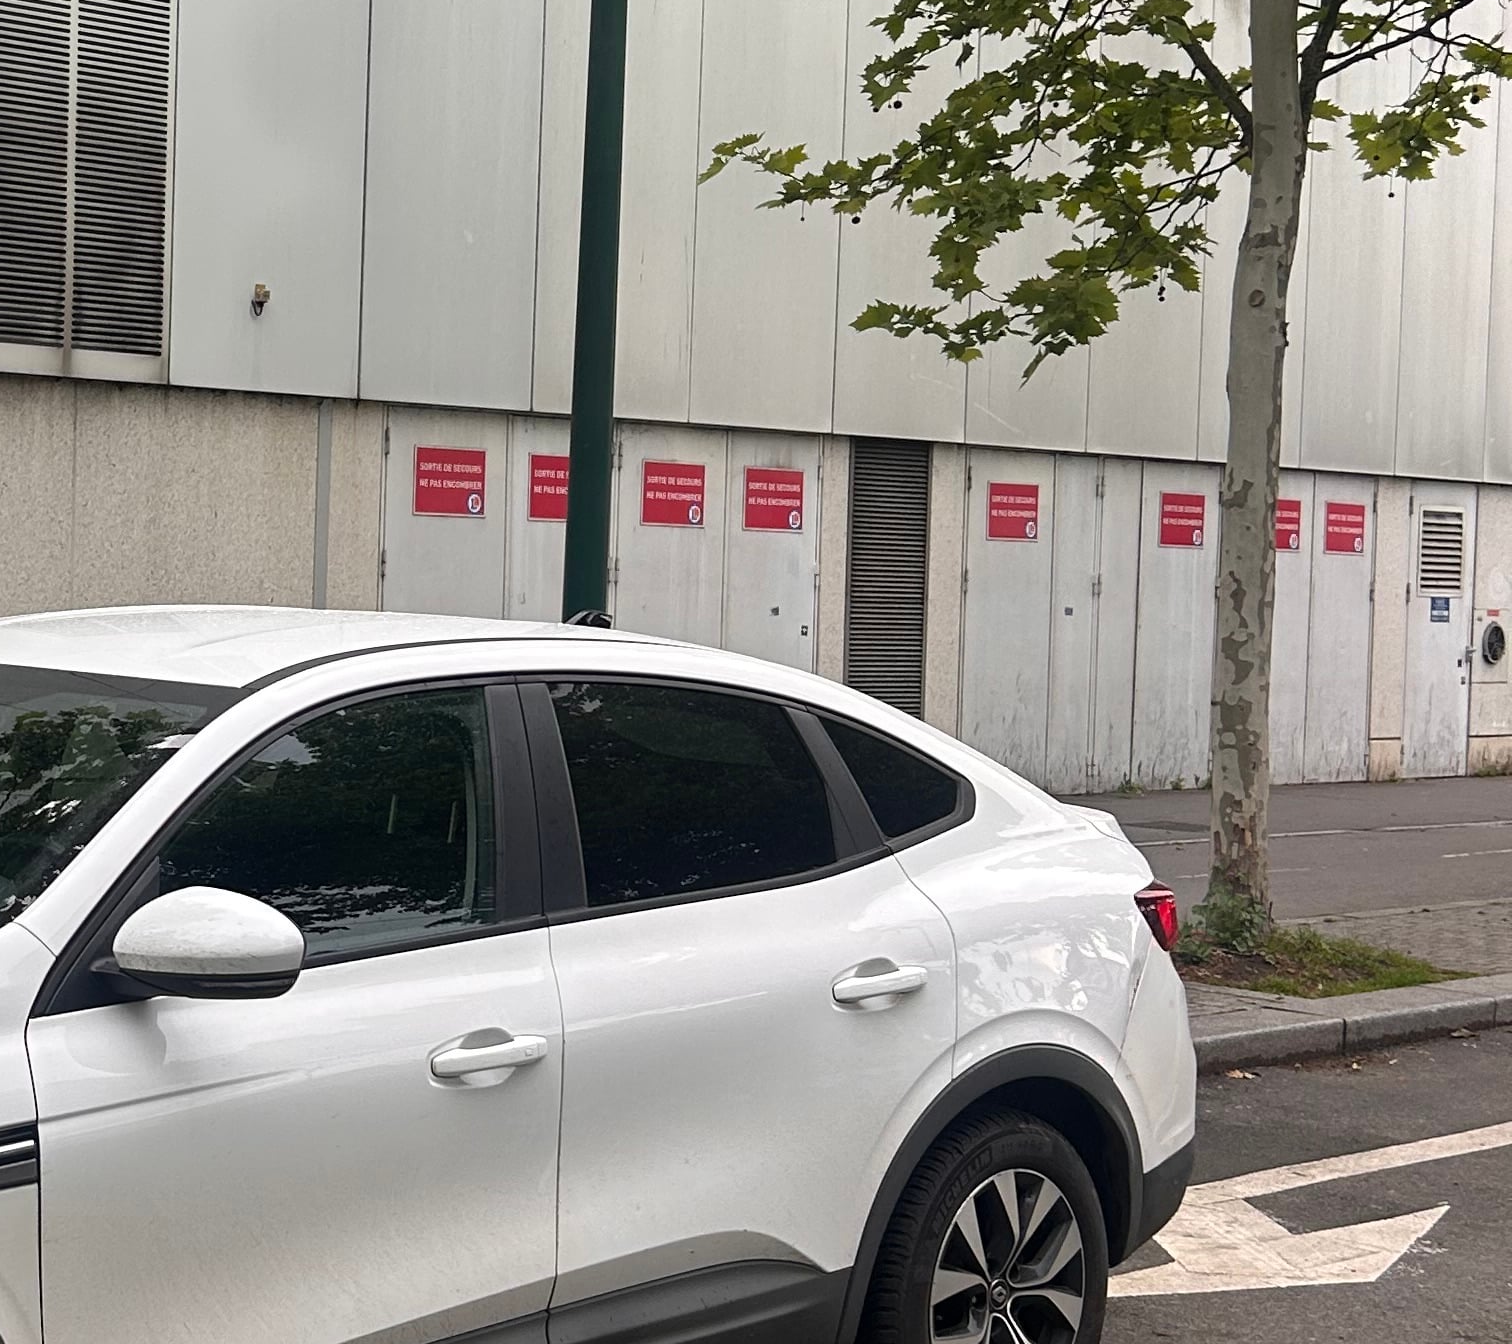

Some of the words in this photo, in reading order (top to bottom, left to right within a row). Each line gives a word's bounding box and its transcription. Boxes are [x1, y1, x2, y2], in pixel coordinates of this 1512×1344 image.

[419, 478, 428, 488] NE
[429, 479, 442, 489] PAS
[932, 1144, 993, 1235] MICHELIN
